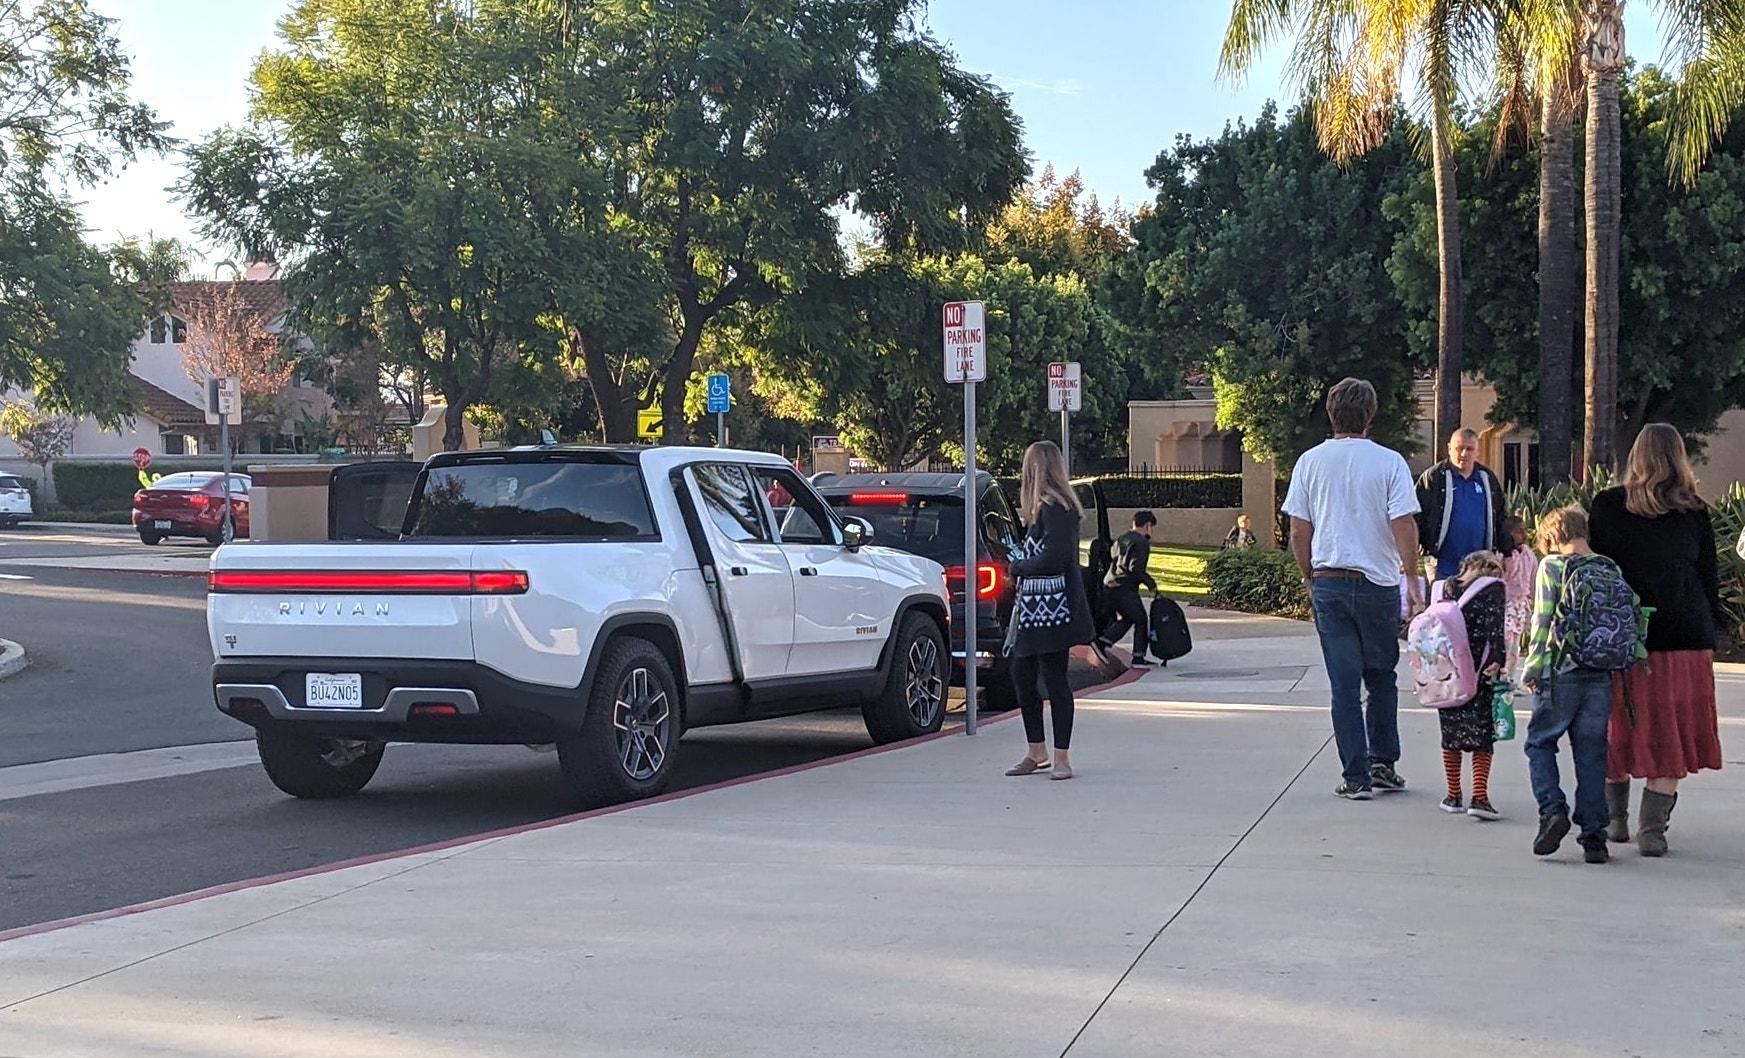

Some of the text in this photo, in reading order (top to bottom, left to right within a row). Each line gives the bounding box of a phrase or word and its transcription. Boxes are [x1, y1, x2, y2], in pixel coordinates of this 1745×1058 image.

[946, 306, 961, 324] NO
[947, 328, 981, 345] PARKING
[956, 347, 974, 358] FIRE
[956, 360, 975, 372] LANE
[1051, 365, 1062, 377] NO
[1051, 379, 1078, 389] PARKING
[1058, 398, 1072, 406] LANE
[279, 602, 390, 616] RIVIAN
